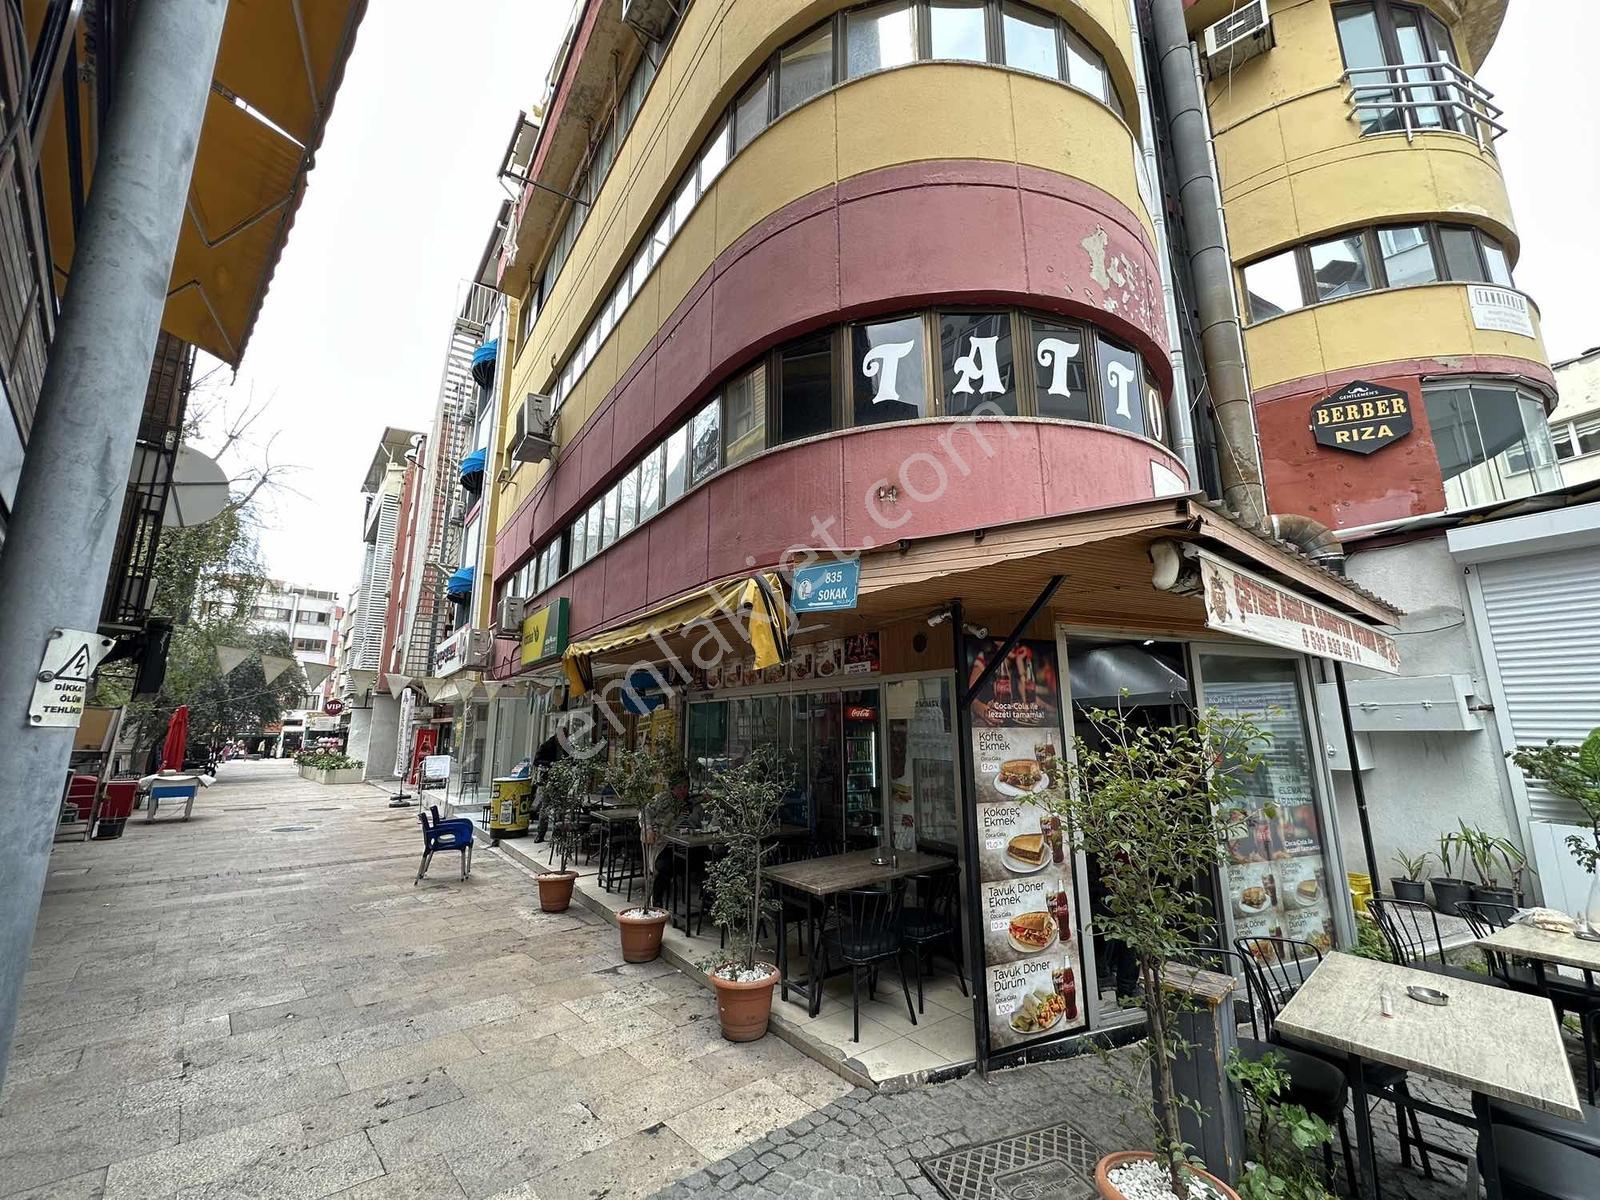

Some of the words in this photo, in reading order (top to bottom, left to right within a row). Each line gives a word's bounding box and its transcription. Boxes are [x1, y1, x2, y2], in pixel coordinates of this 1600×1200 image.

[1316, 397, 1407, 425] BERBER
[1335, 424, 1394, 444] RIZA
[825, 571, 842, 584] 835
[818, 587, 848, 601] SOKAK
[988, 710, 1012, 718] lezzeti
[979, 732, 1003, 742] Köfte
[979, 741, 1011, 751] Ekmek
[983, 807, 1021, 817] Kokoreç
[984, 816, 1016, 828] Ekmek
[988, 883, 1015, 897] Tavuk
[1018, 880, 1045, 893] Döner
[989, 895, 1021, 908] Ekmek
[993, 966, 1021, 981] Tavuk
[1023, 961, 1050, 974] Döner
[994, 977, 1026, 992] Dürüm
